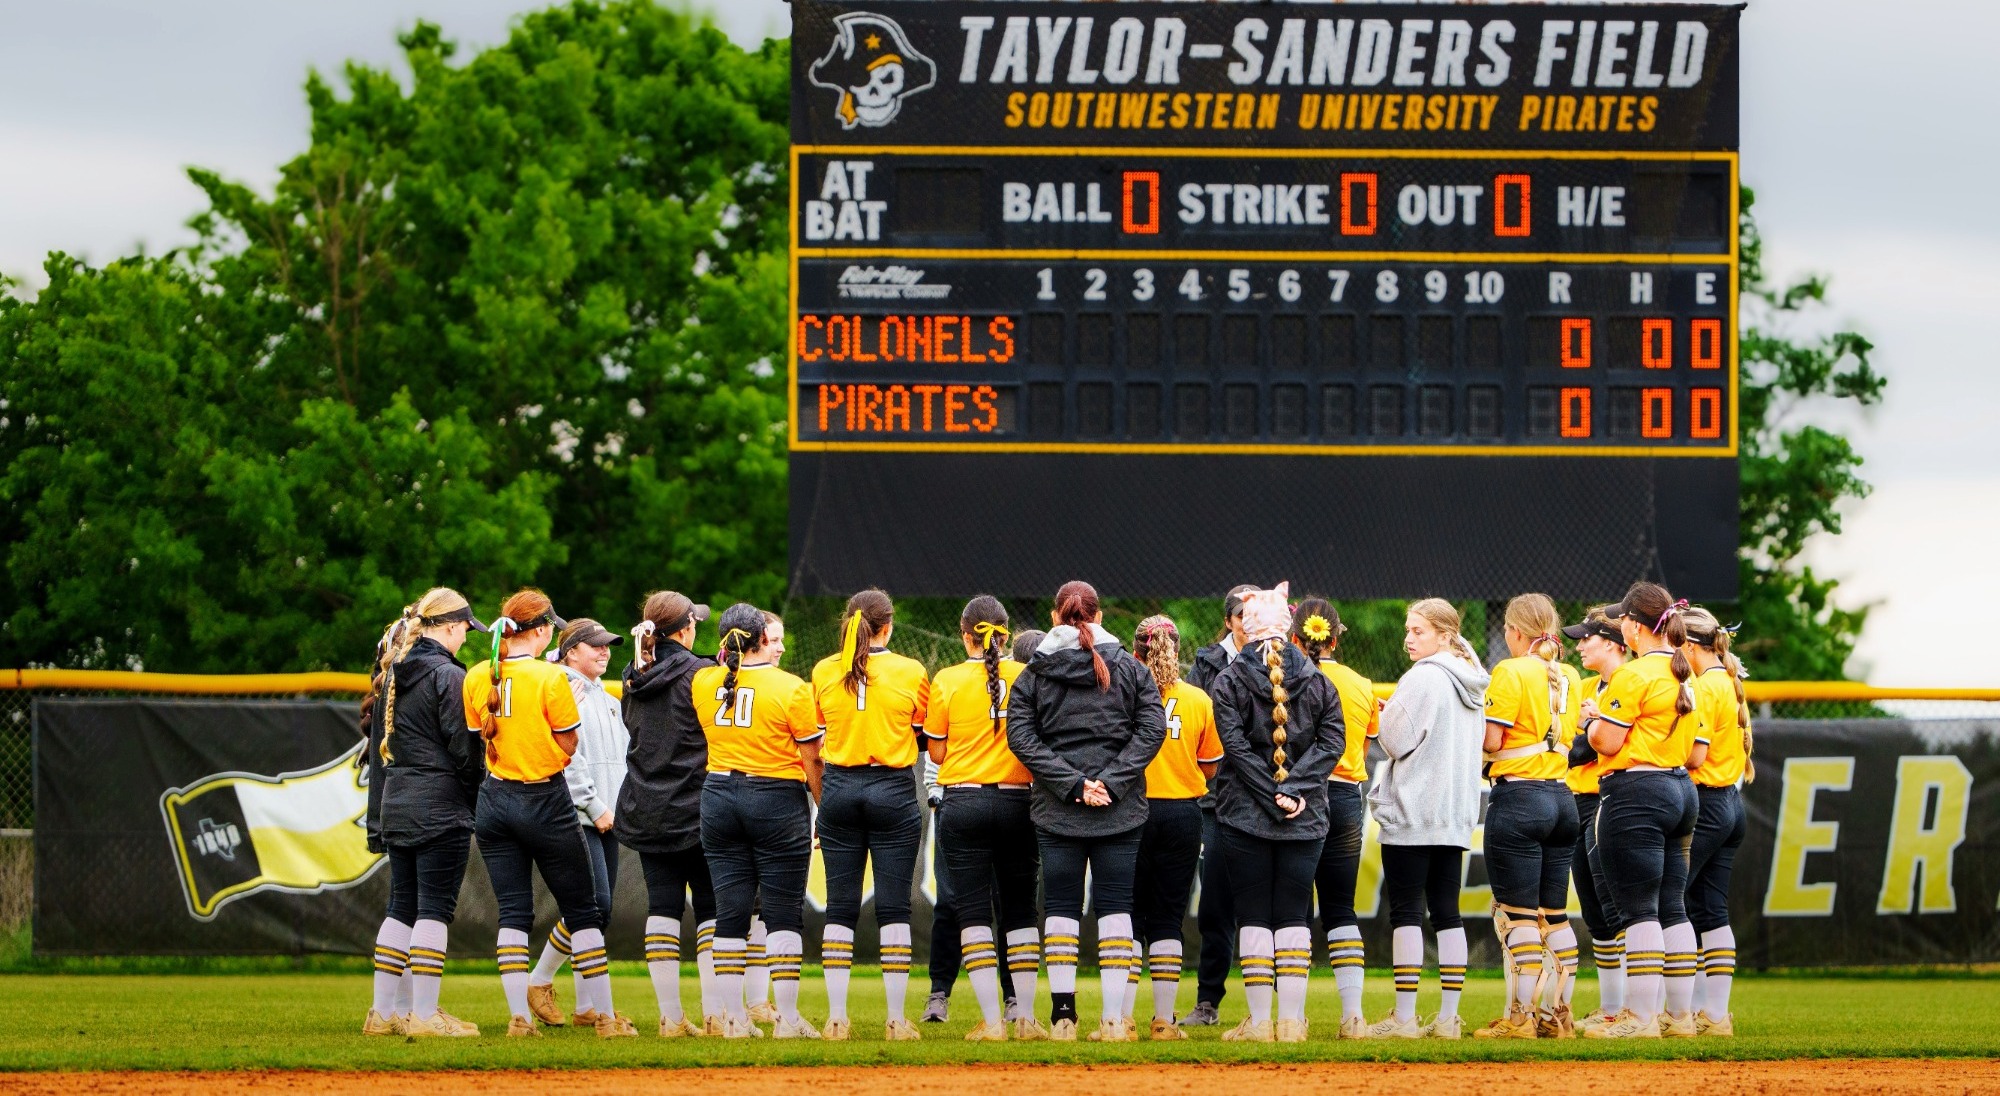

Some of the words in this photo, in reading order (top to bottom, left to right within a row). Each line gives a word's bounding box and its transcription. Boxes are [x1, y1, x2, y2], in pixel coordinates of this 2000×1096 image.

[960, 17, 1516, 86] TAYLOR-SANDERS
[1534, 21, 1708, 87] FIELD
[1005, 92, 1280, 128] SOUTHWESTERN
[1299, 94, 1498, 130] UNIVERSITY
[1520, 96, 1658, 131] PIRATES
[821, 161, 873, 200] AT
[806, 201, 887, 240] BAT
[1003, 183, 1111, 222] BALL
[1123, 172, 1159, 234] 0
[1179, 184, 1329, 224] STRIKE
[1341, 173, 1377, 235] 0
[1398, 185, 1483, 225] OUT
[1495, 174, 1530, 236] 0
[1558, 187, 1625, 226] H/E
[1038, 268, 1056, 300] 1
[1085, 269, 1106, 300] 2
[1133, 269, 1154, 300] 3
[1179, 269, 1202, 300] 4
[1228, 270, 1250, 301] 5
[1279, 270, 1301, 301] 6
[1329, 270, 1349, 301] 7
[1376, 270, 1398, 302] 8
[1425, 271, 1447, 302] 9
[1465, 271, 1504, 303] 10
[1550, 272, 1571, 303] R
[1631, 272, 1652, 303] H
[1697, 273, 1716, 304] E
[797, 316, 1014, 363] COLONELS
[1561, 319, 1591, 368] 0
[1642, 319, 1672, 368] 0
[1691, 319, 1720, 368] 0
[819, 384, 998, 432] PIRATES
[1561, 388, 1590, 438] 0
[1642, 388, 1671, 438] 0
[1691, 389, 1720, 438] 0
[714, 686, 755, 728] 20
[196, 824, 242, 856] 1840
